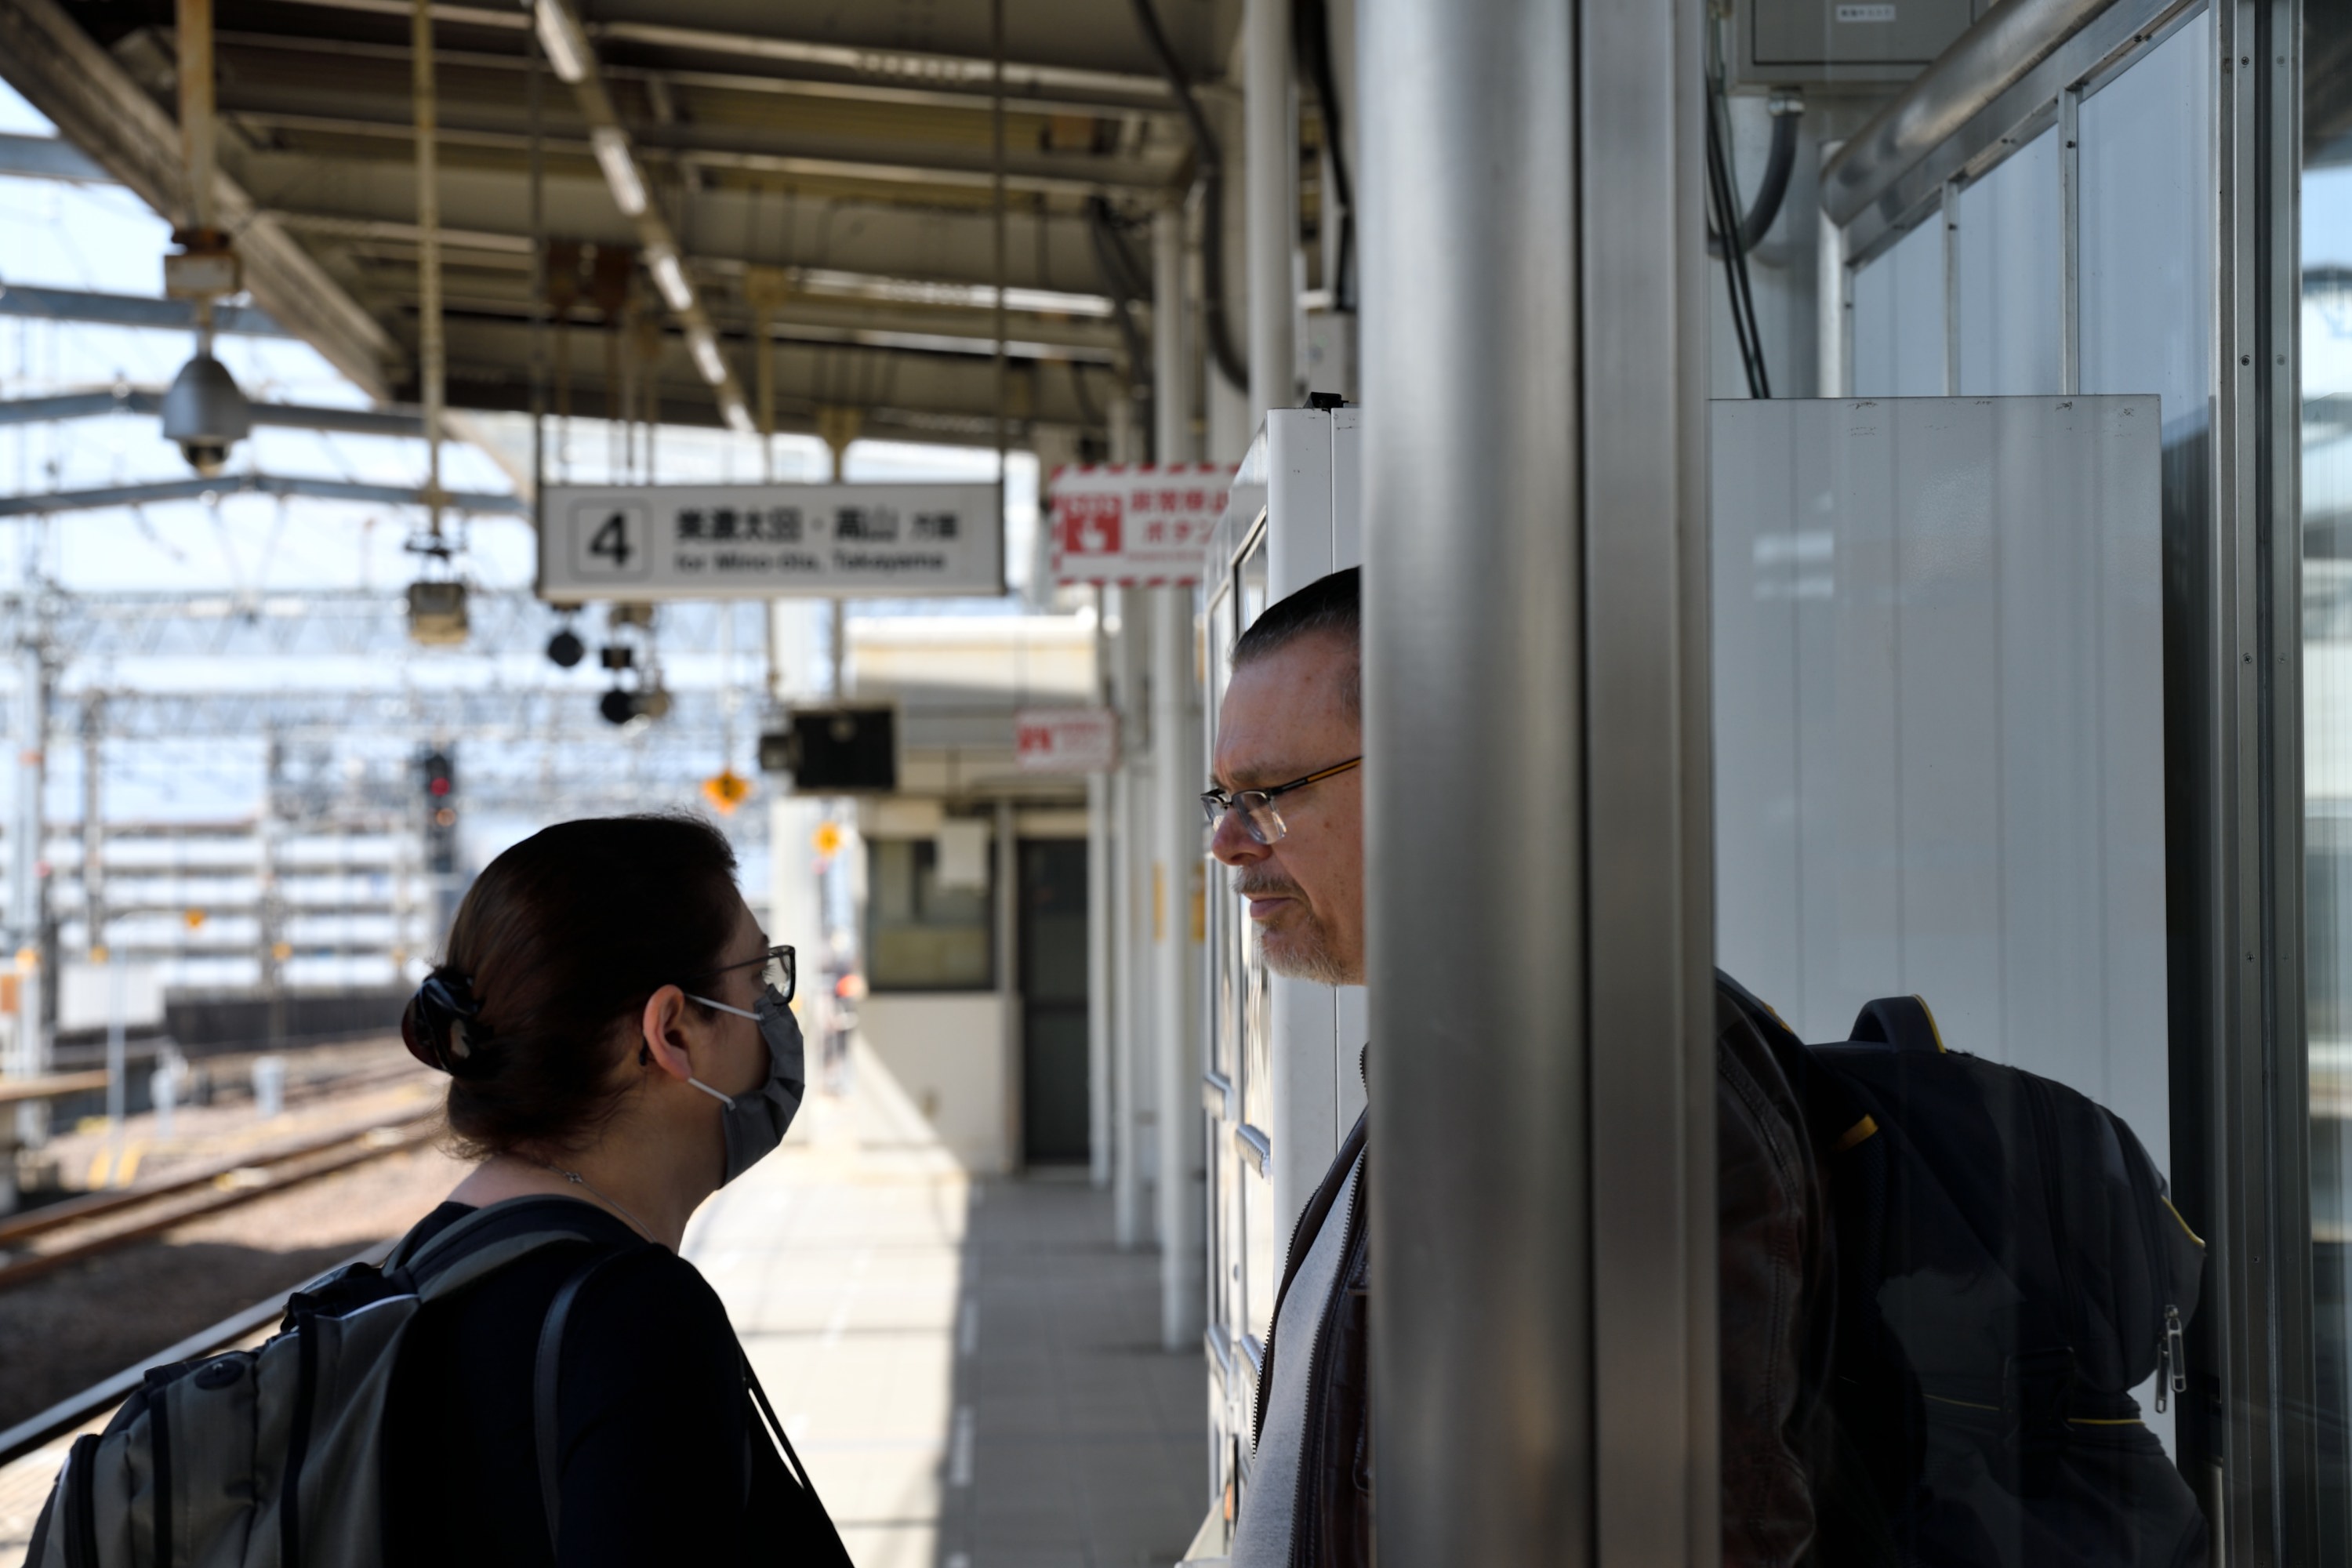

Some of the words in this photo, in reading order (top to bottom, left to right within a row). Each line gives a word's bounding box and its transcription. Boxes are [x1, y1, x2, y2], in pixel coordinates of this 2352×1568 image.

[588, 510, 633, 568] 4
[673, 552, 706, 572] for
[833, 552, 946, 573] Takayama
